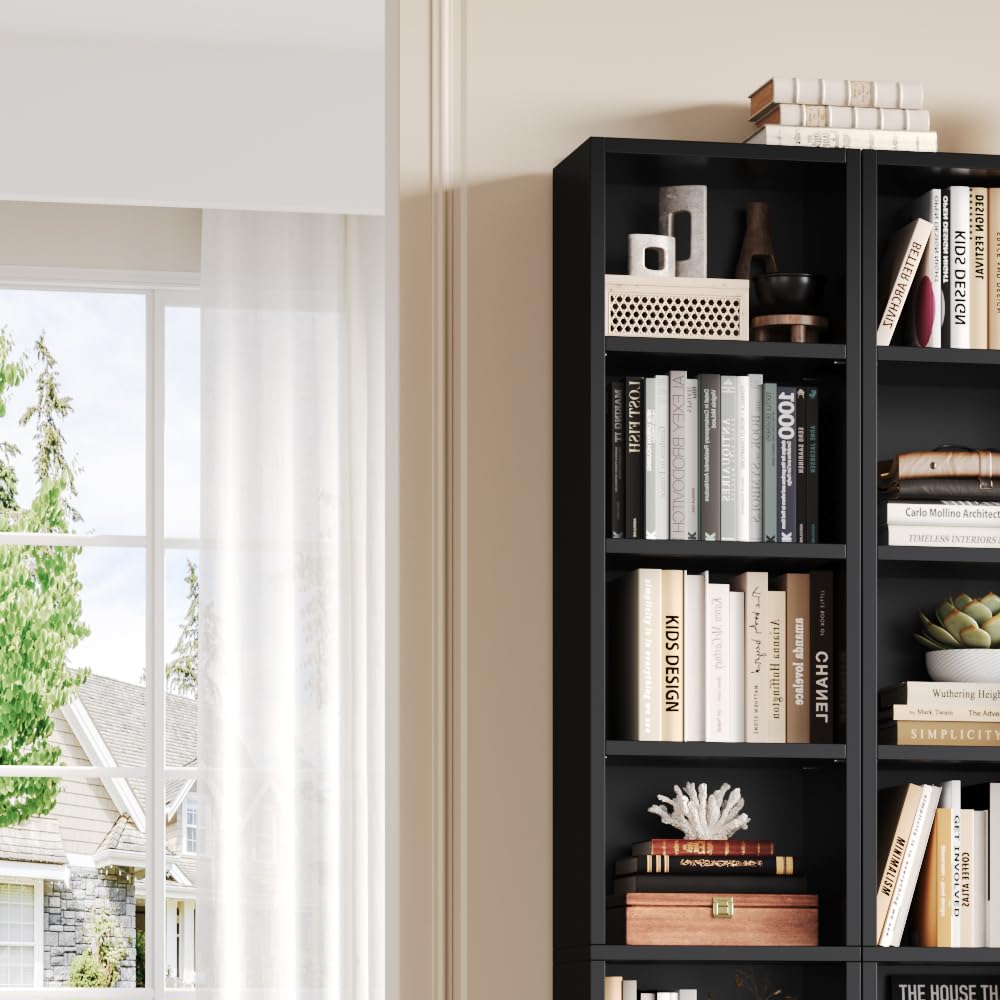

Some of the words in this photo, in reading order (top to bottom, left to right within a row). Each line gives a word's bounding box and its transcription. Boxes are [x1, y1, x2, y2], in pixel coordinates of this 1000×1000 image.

[905, 507, 927, 517] Carlo
[929, 508, 961, 518] Mollino
[963, 509, 1000, 519] Architect
[908, 534, 950, 543] TIMELESS
[951, 535, 997, 544] INTERIORS
[665, 615, 680, 651] KIDS
[665, 656, 680, 712] DESIGN
[932, 688, 976, 700] Wuthering
[881, 837, 906, 897] MINIMALISM
